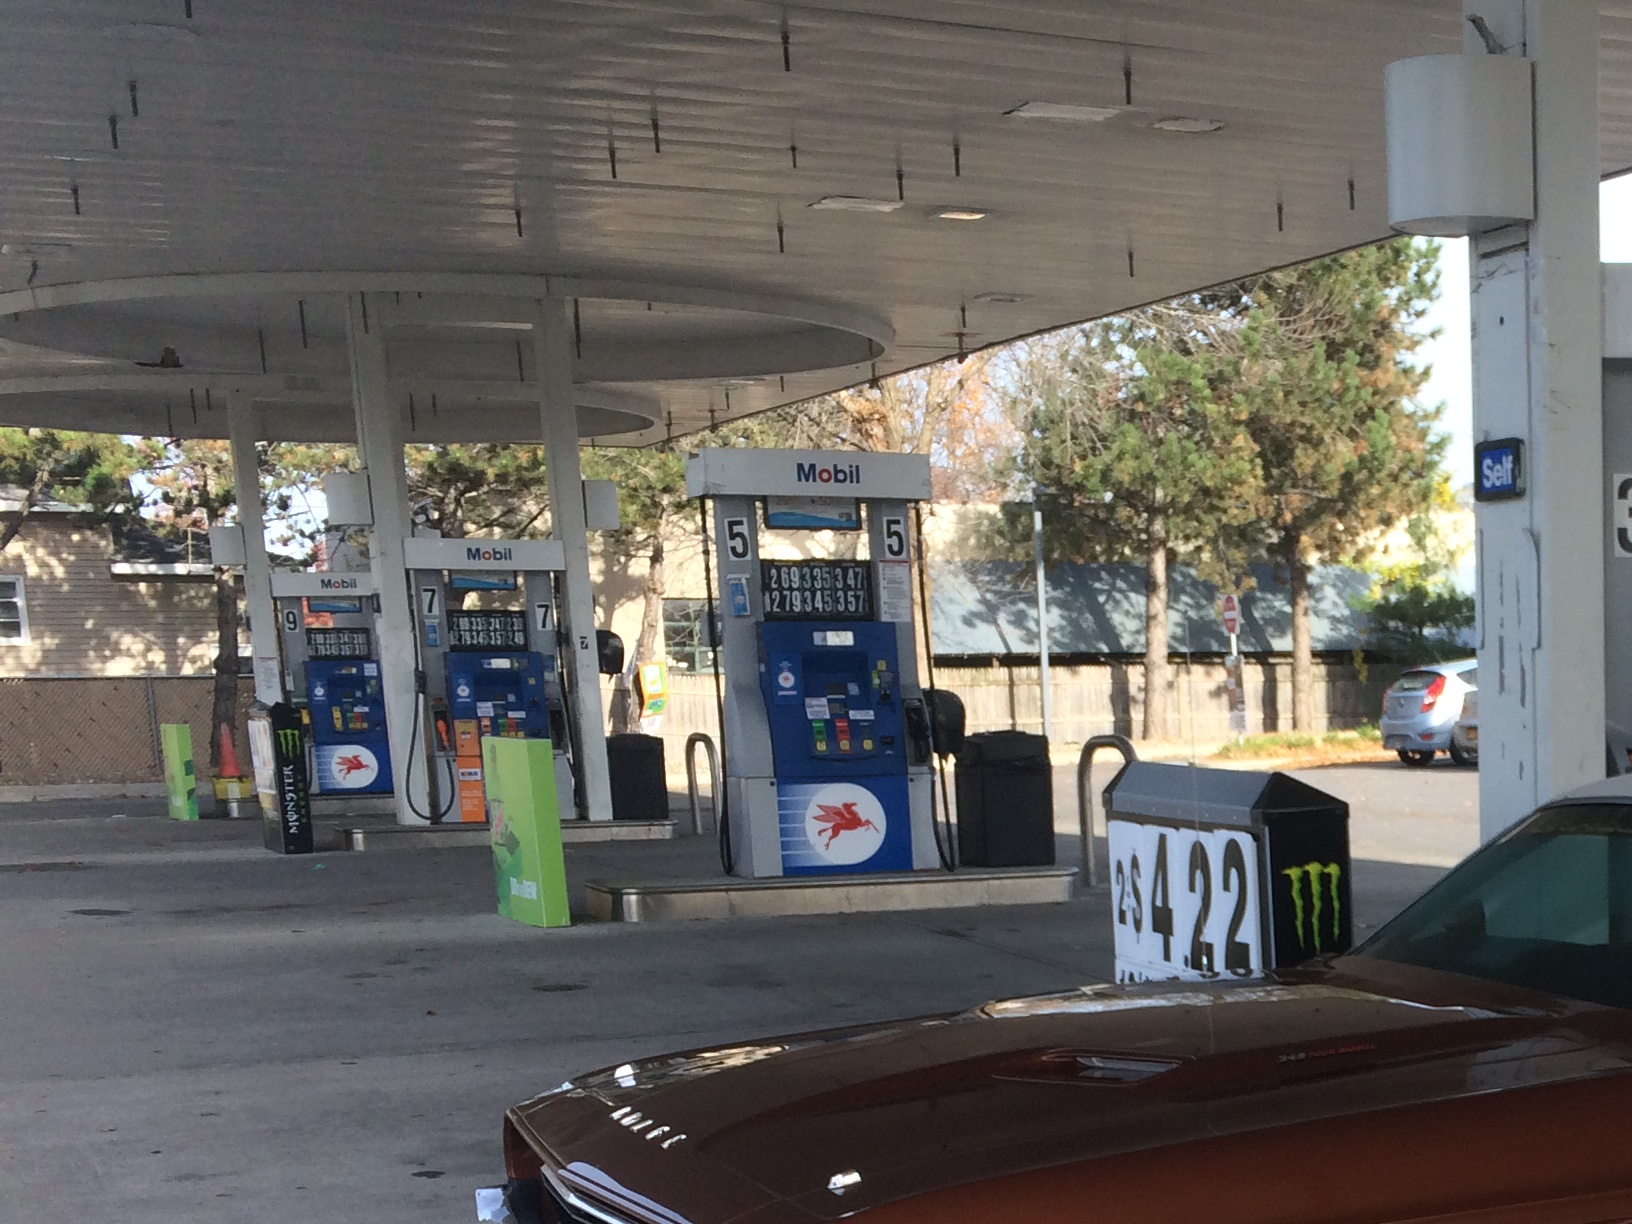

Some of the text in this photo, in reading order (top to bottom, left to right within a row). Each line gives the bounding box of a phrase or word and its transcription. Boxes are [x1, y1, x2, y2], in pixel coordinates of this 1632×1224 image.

[796, 463, 860, 484] Mobil
[1483, 455, 1513, 488] Self
[727, 520, 749, 559] 5
[886, 519, 905, 557] 5
[466, 547, 513, 561] Mobil
[320, 578, 357, 589] Mobil
[423, 588, 436, 613] 7
[285, 611, 297, 630] 9
[537, 603, 549, 629] 7
[282, 765, 299, 833] MONSTER
